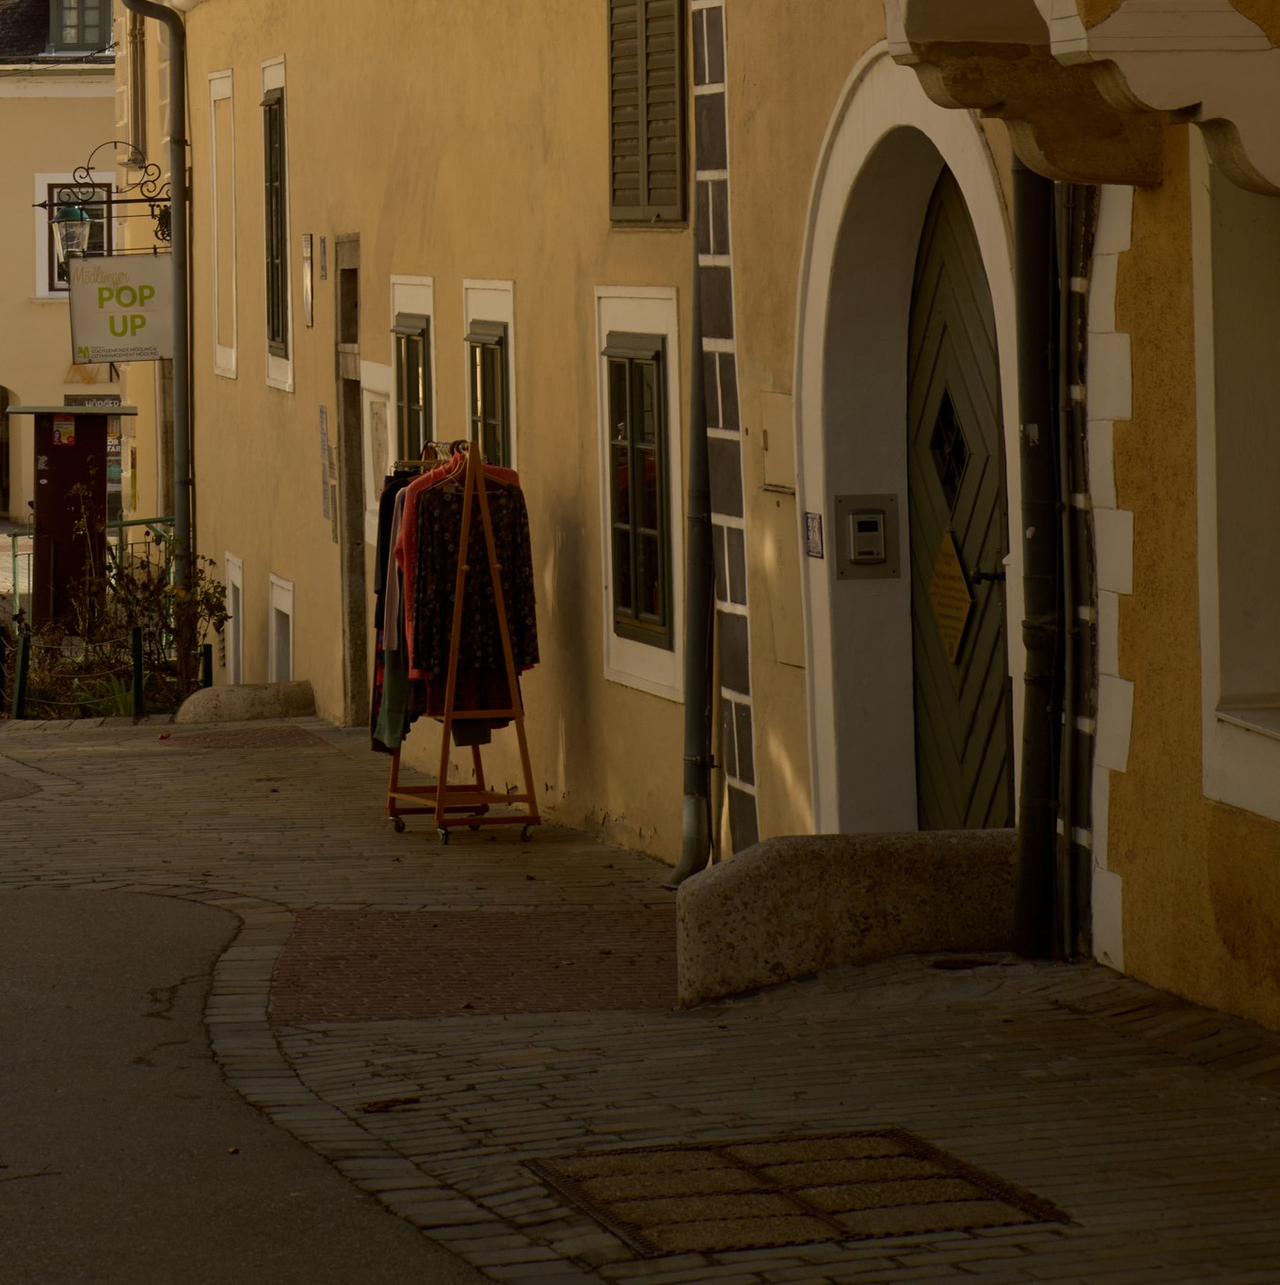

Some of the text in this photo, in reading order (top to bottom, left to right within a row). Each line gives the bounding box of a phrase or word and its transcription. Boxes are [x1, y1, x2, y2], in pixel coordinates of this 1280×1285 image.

[73, 266, 130, 289] Mödlinger
[98, 285, 155, 309] POP
[109, 314, 146, 337] UP
